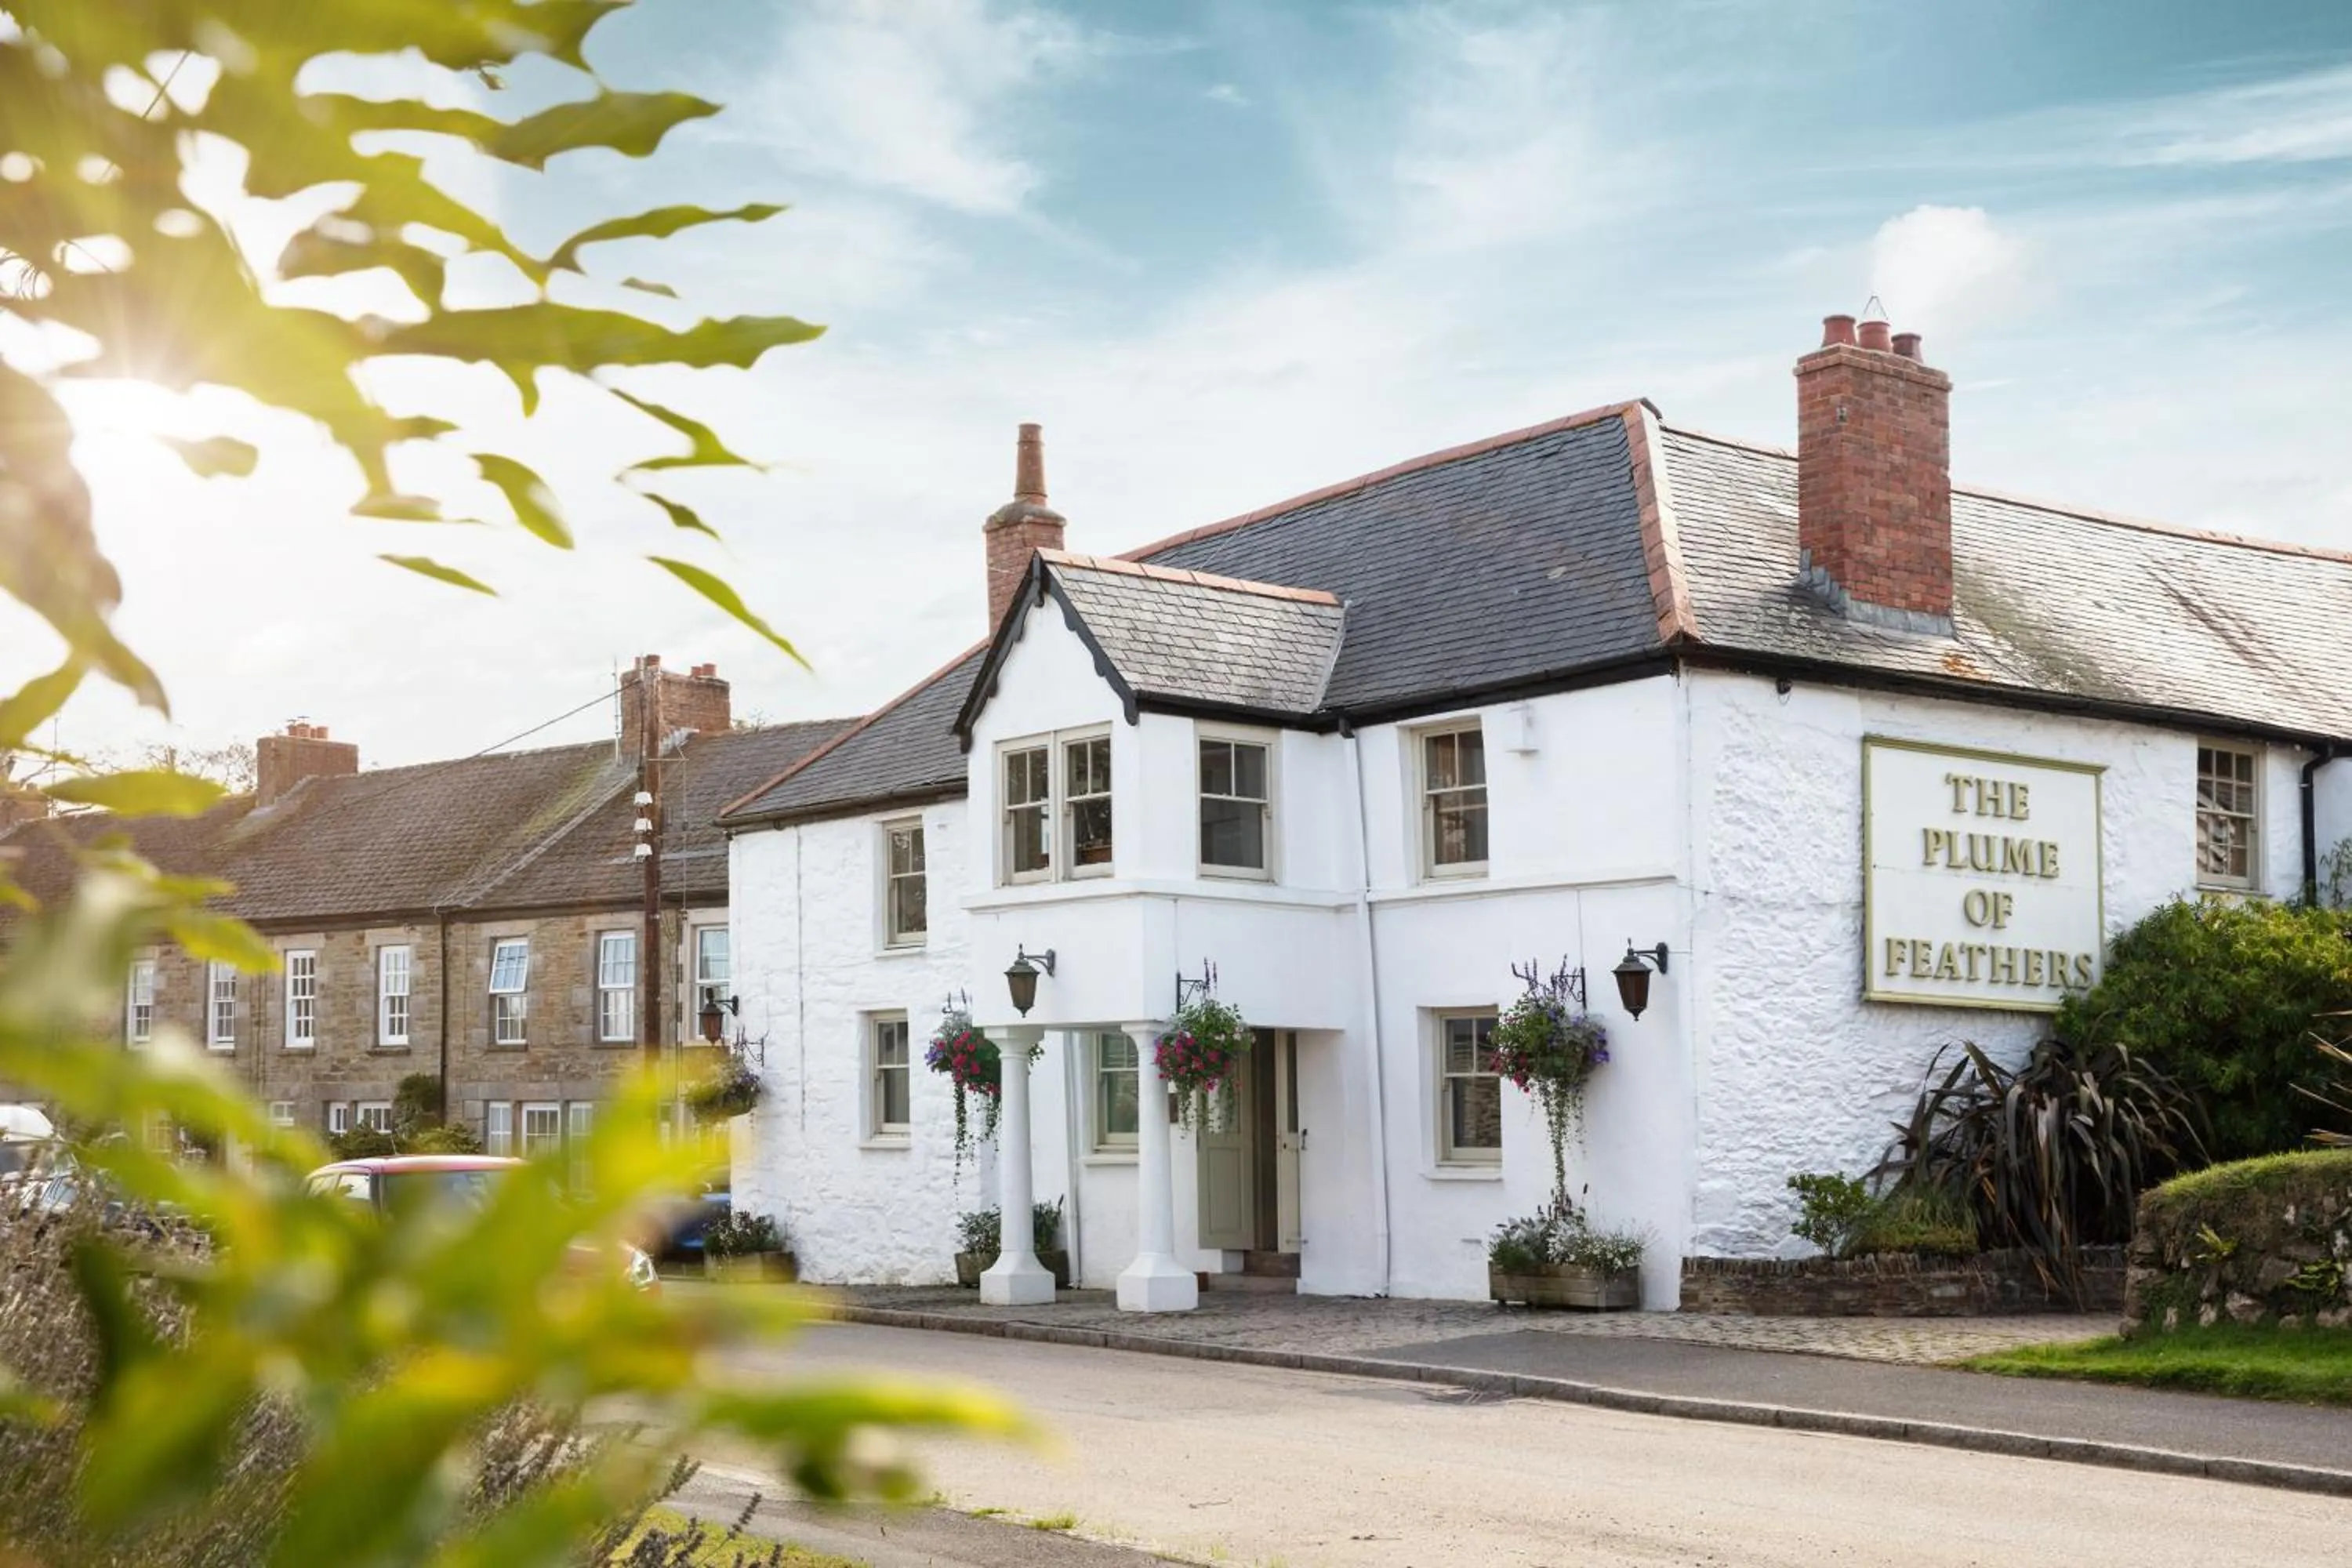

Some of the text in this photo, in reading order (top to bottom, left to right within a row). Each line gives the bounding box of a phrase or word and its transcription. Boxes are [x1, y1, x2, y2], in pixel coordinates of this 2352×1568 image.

[1945, 772, 2030, 820] THE
[1922, 827, 2059, 879] PLUME
[1963, 888, 2013, 929] OF
[1885, 937, 2093, 989] FEATHERS
